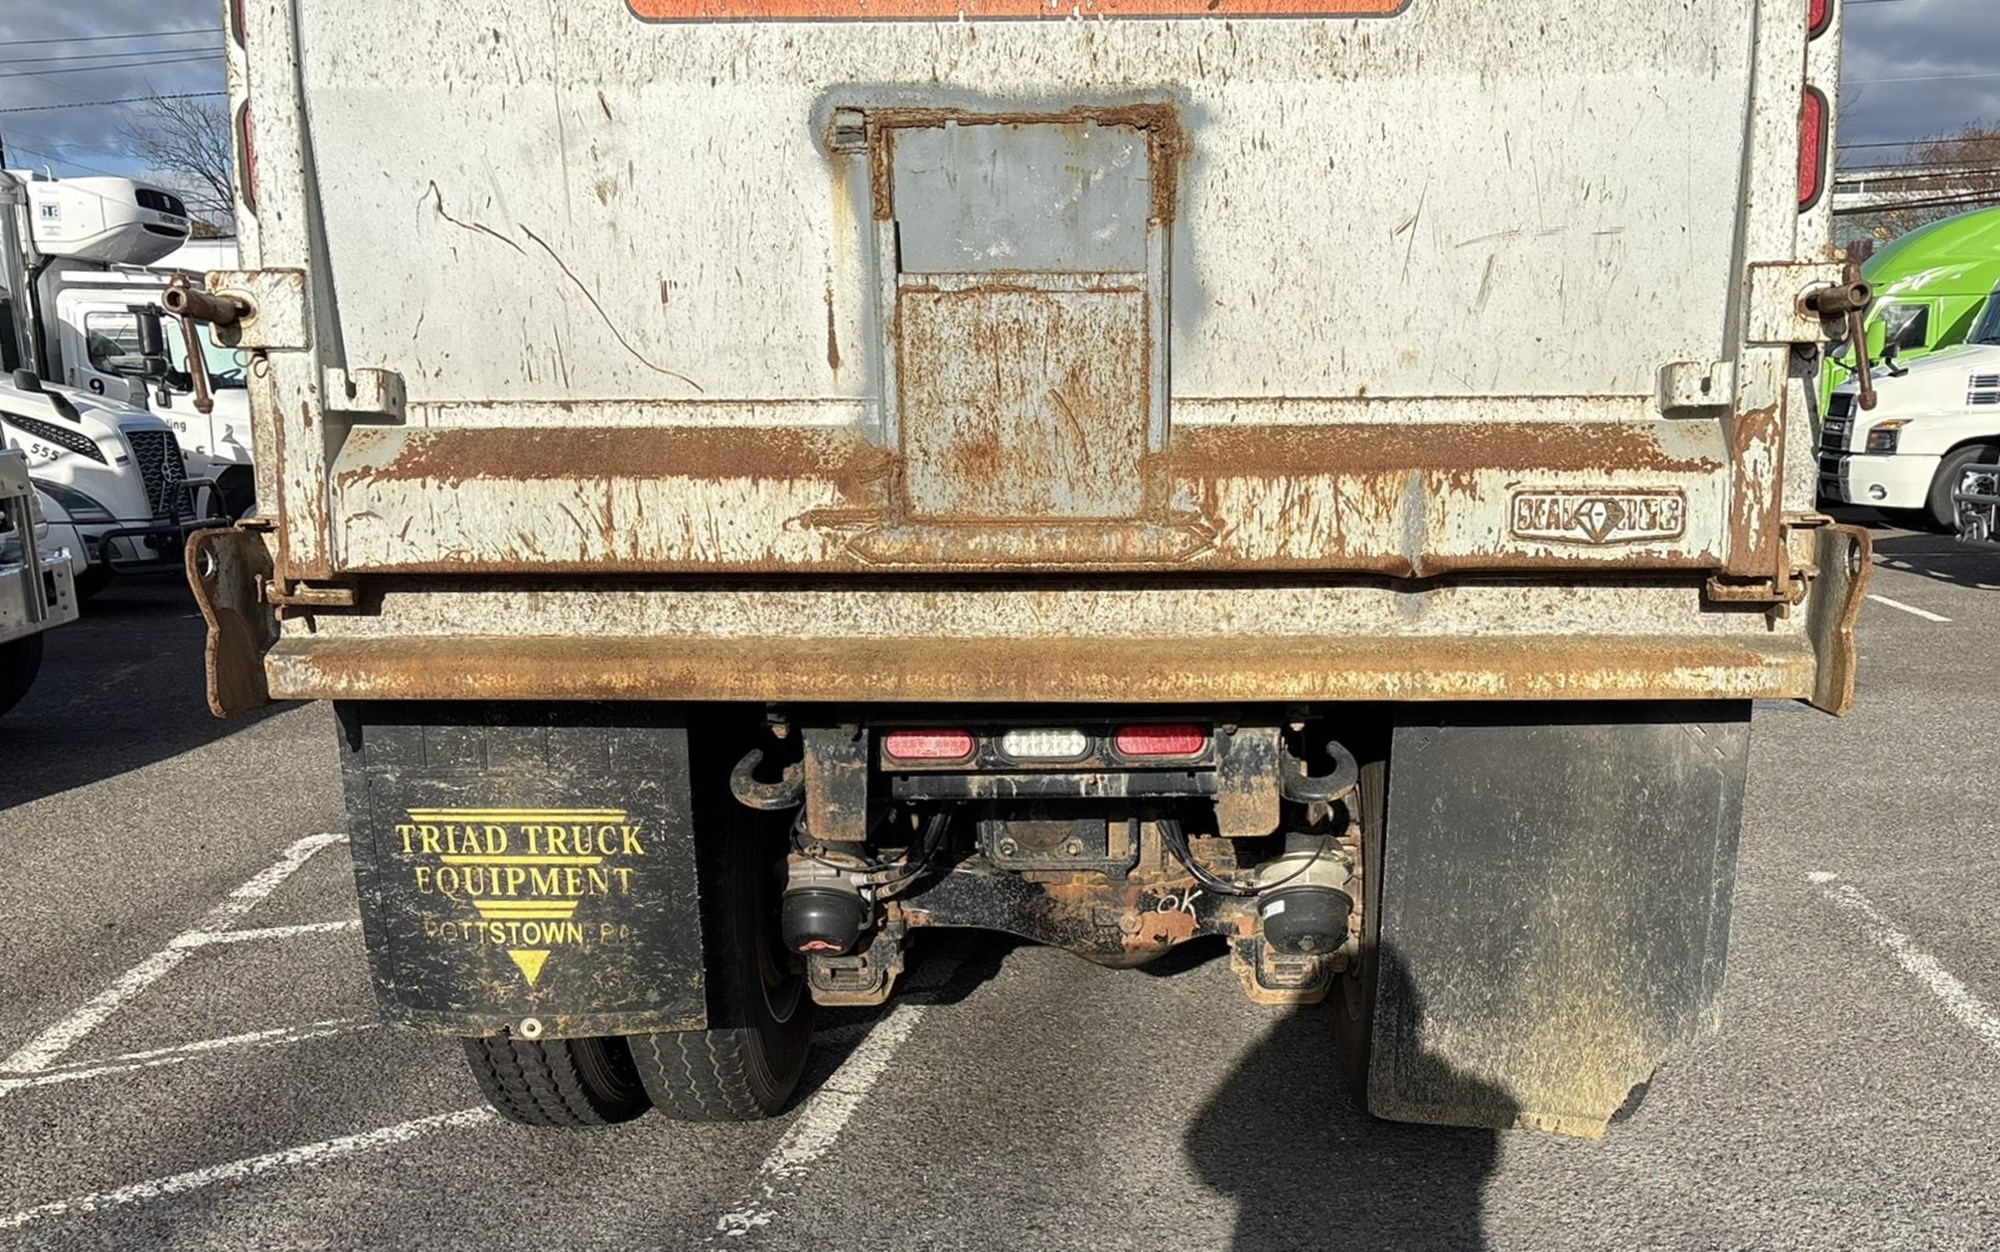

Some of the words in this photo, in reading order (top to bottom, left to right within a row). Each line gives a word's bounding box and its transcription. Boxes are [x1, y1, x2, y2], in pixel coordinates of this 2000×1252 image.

[89, 378, 105, 396] 9
[30, 443, 60, 462] 555
[395, 824, 508, 855] TRIAD
[522, 824, 646, 856] TRUCK
[415, 866, 635, 904] EQUIPMENT
[1157, 890, 1203, 929] OK
[425, 921, 585, 946] POTTSTOWN
